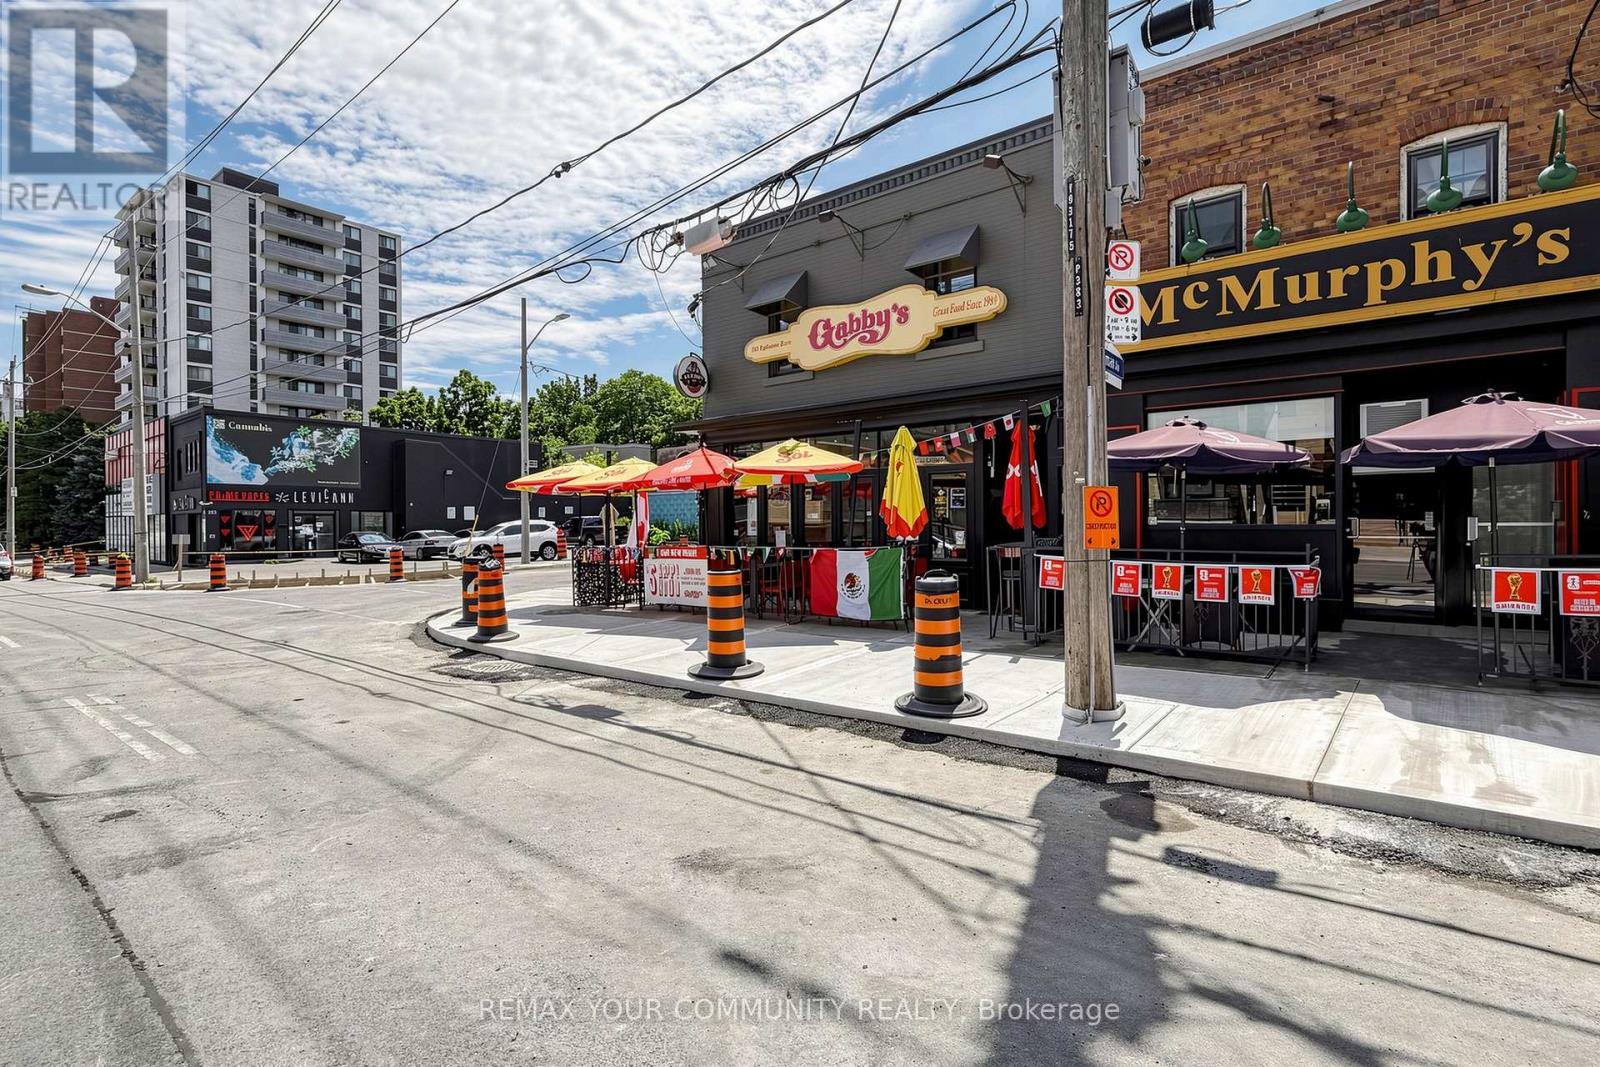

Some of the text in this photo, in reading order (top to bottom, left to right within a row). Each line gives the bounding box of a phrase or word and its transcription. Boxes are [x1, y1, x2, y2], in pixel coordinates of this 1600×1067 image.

[1067, 183, 1075, 251] 193175
[1140, 221, 1571, 327] McMurphy's
[807, 302, 910, 351] Gabby's
[228, 421, 272, 432] Cannabis
